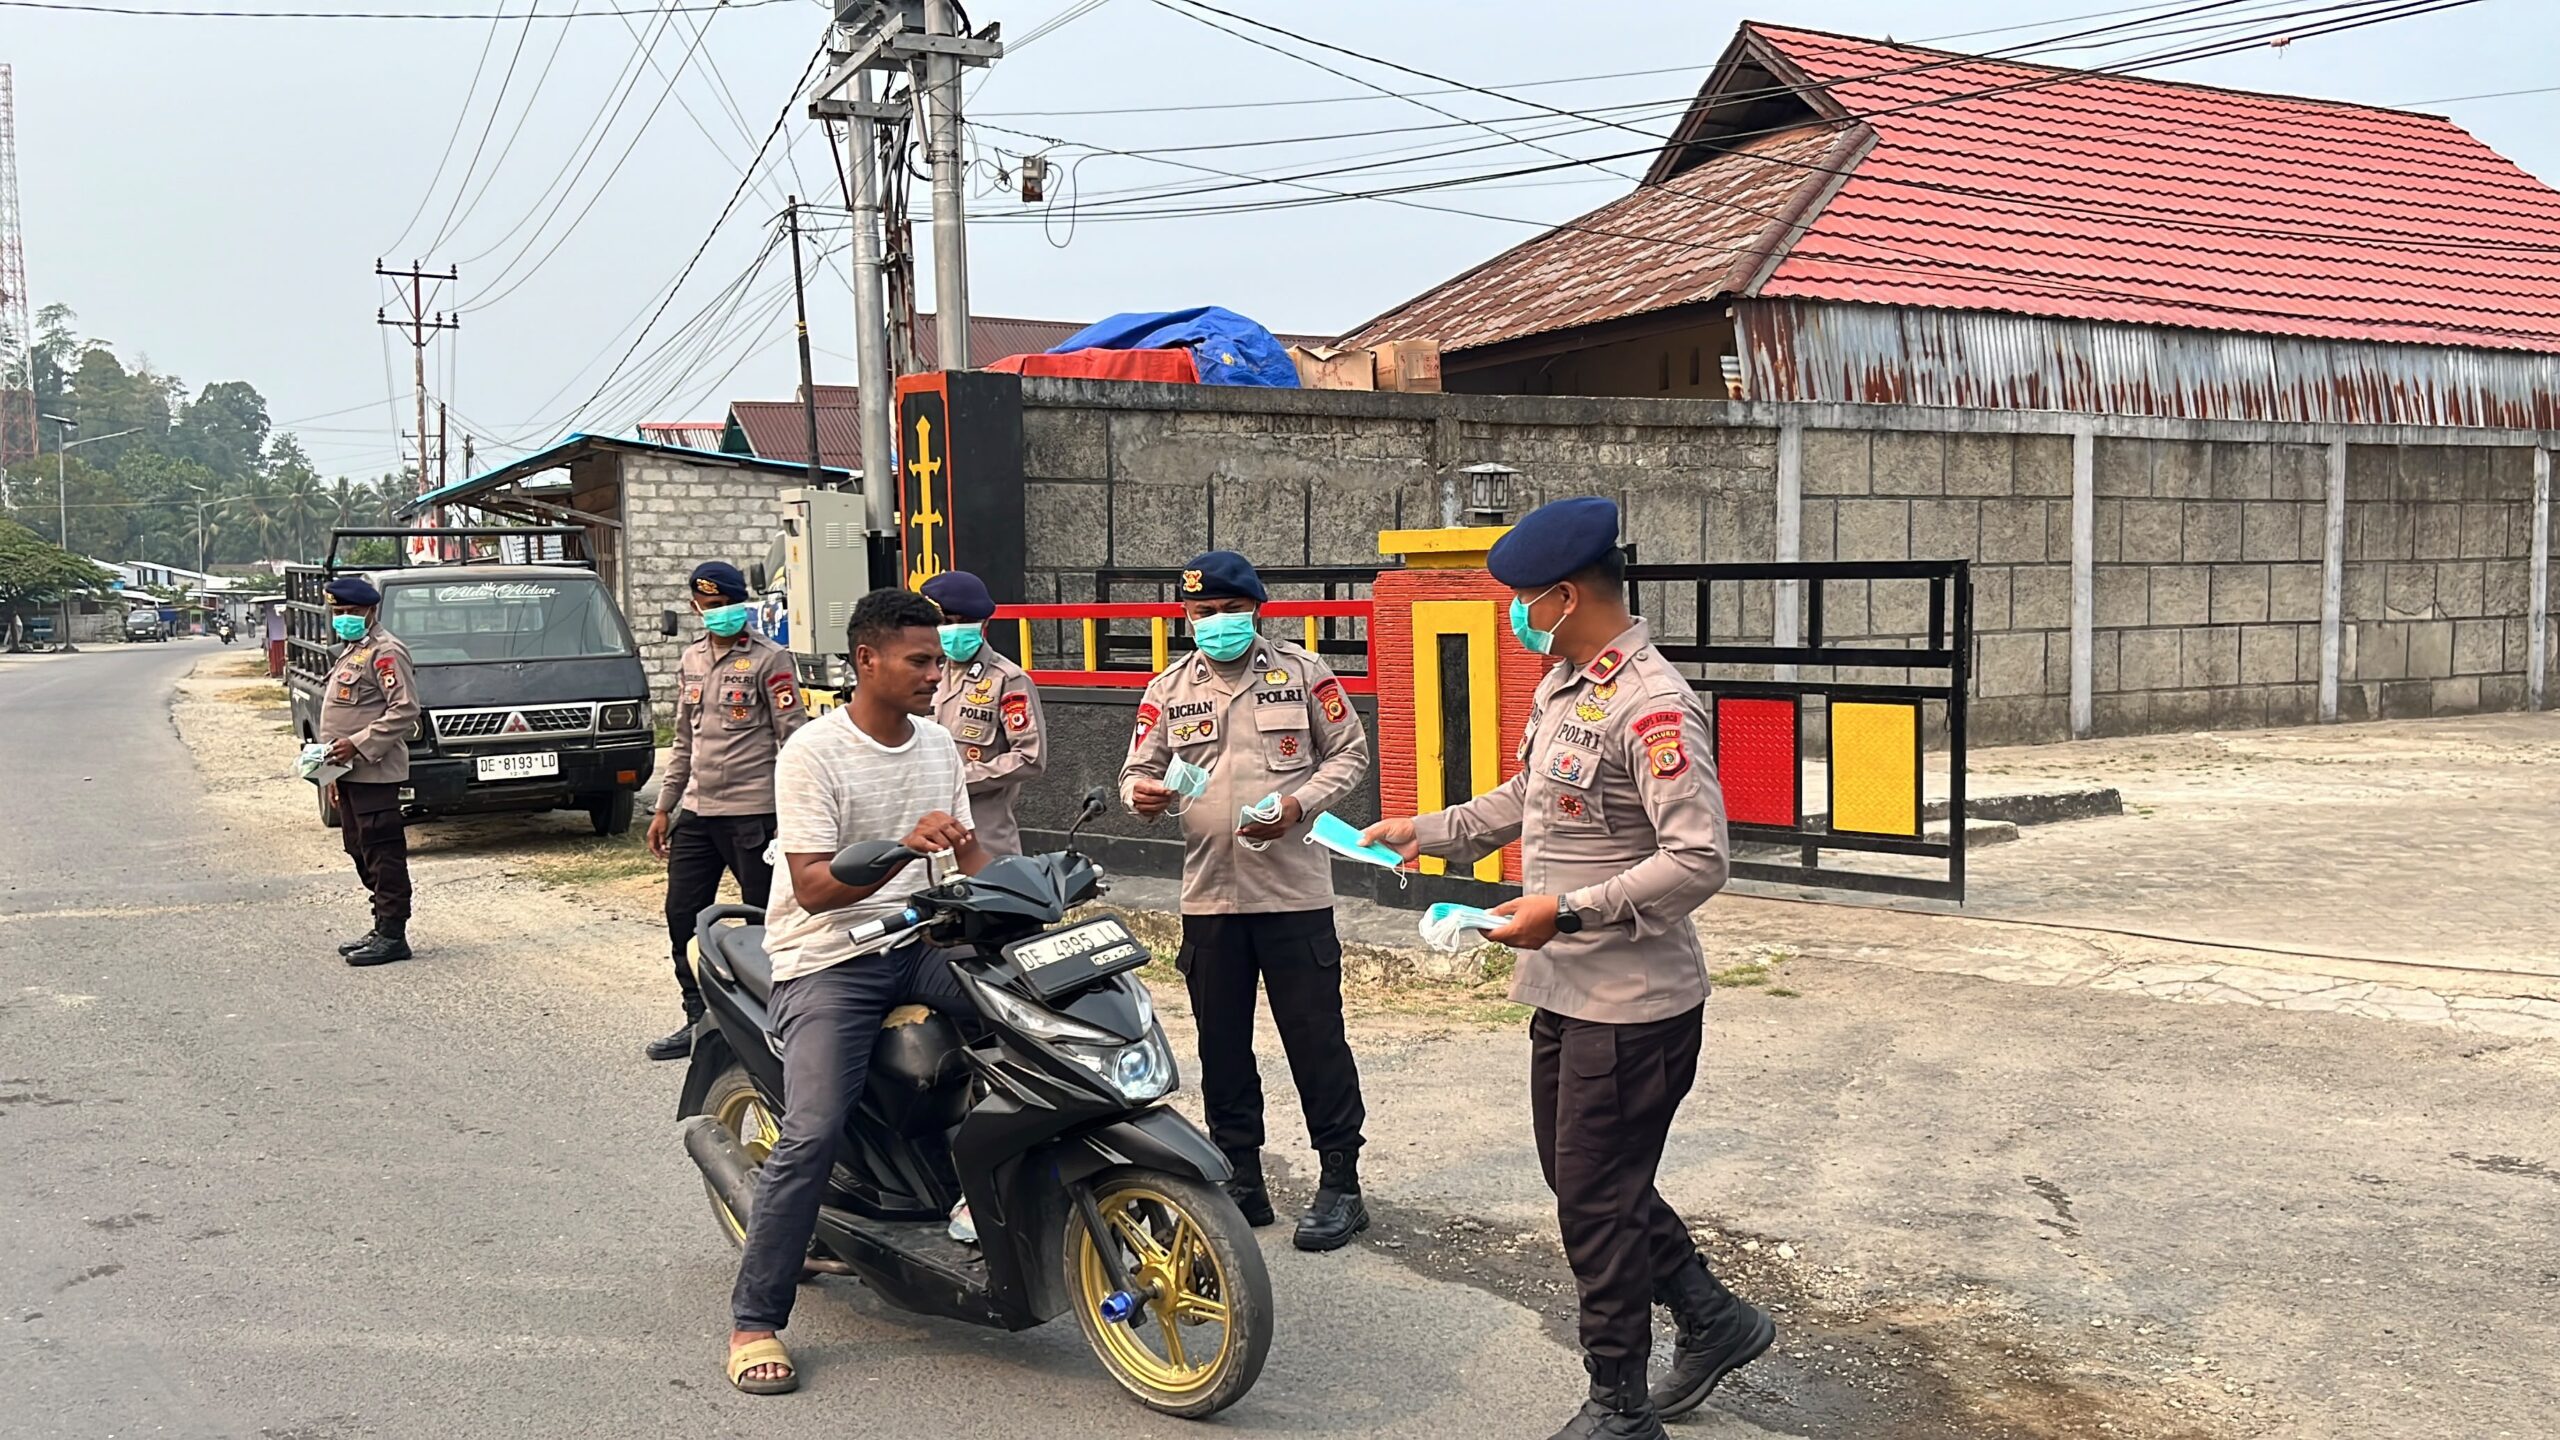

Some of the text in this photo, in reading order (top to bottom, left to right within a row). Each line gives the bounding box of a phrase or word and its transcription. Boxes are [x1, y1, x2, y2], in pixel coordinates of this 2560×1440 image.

[723, 675, 754, 684] POLRI
[1256, 689, 1303, 705] POLRI
[959, 706, 993, 722] POLRI
[1168, 701, 1213, 720] RICHAN
[1558, 723, 1600, 750] POLRI
[1646, 731, 1677, 744] MALUKU
[480, 754, 555, 772] DE 8193 LD
[1017, 949, 1046, 969] DE
[1053, 932, 1095, 958] 4895
